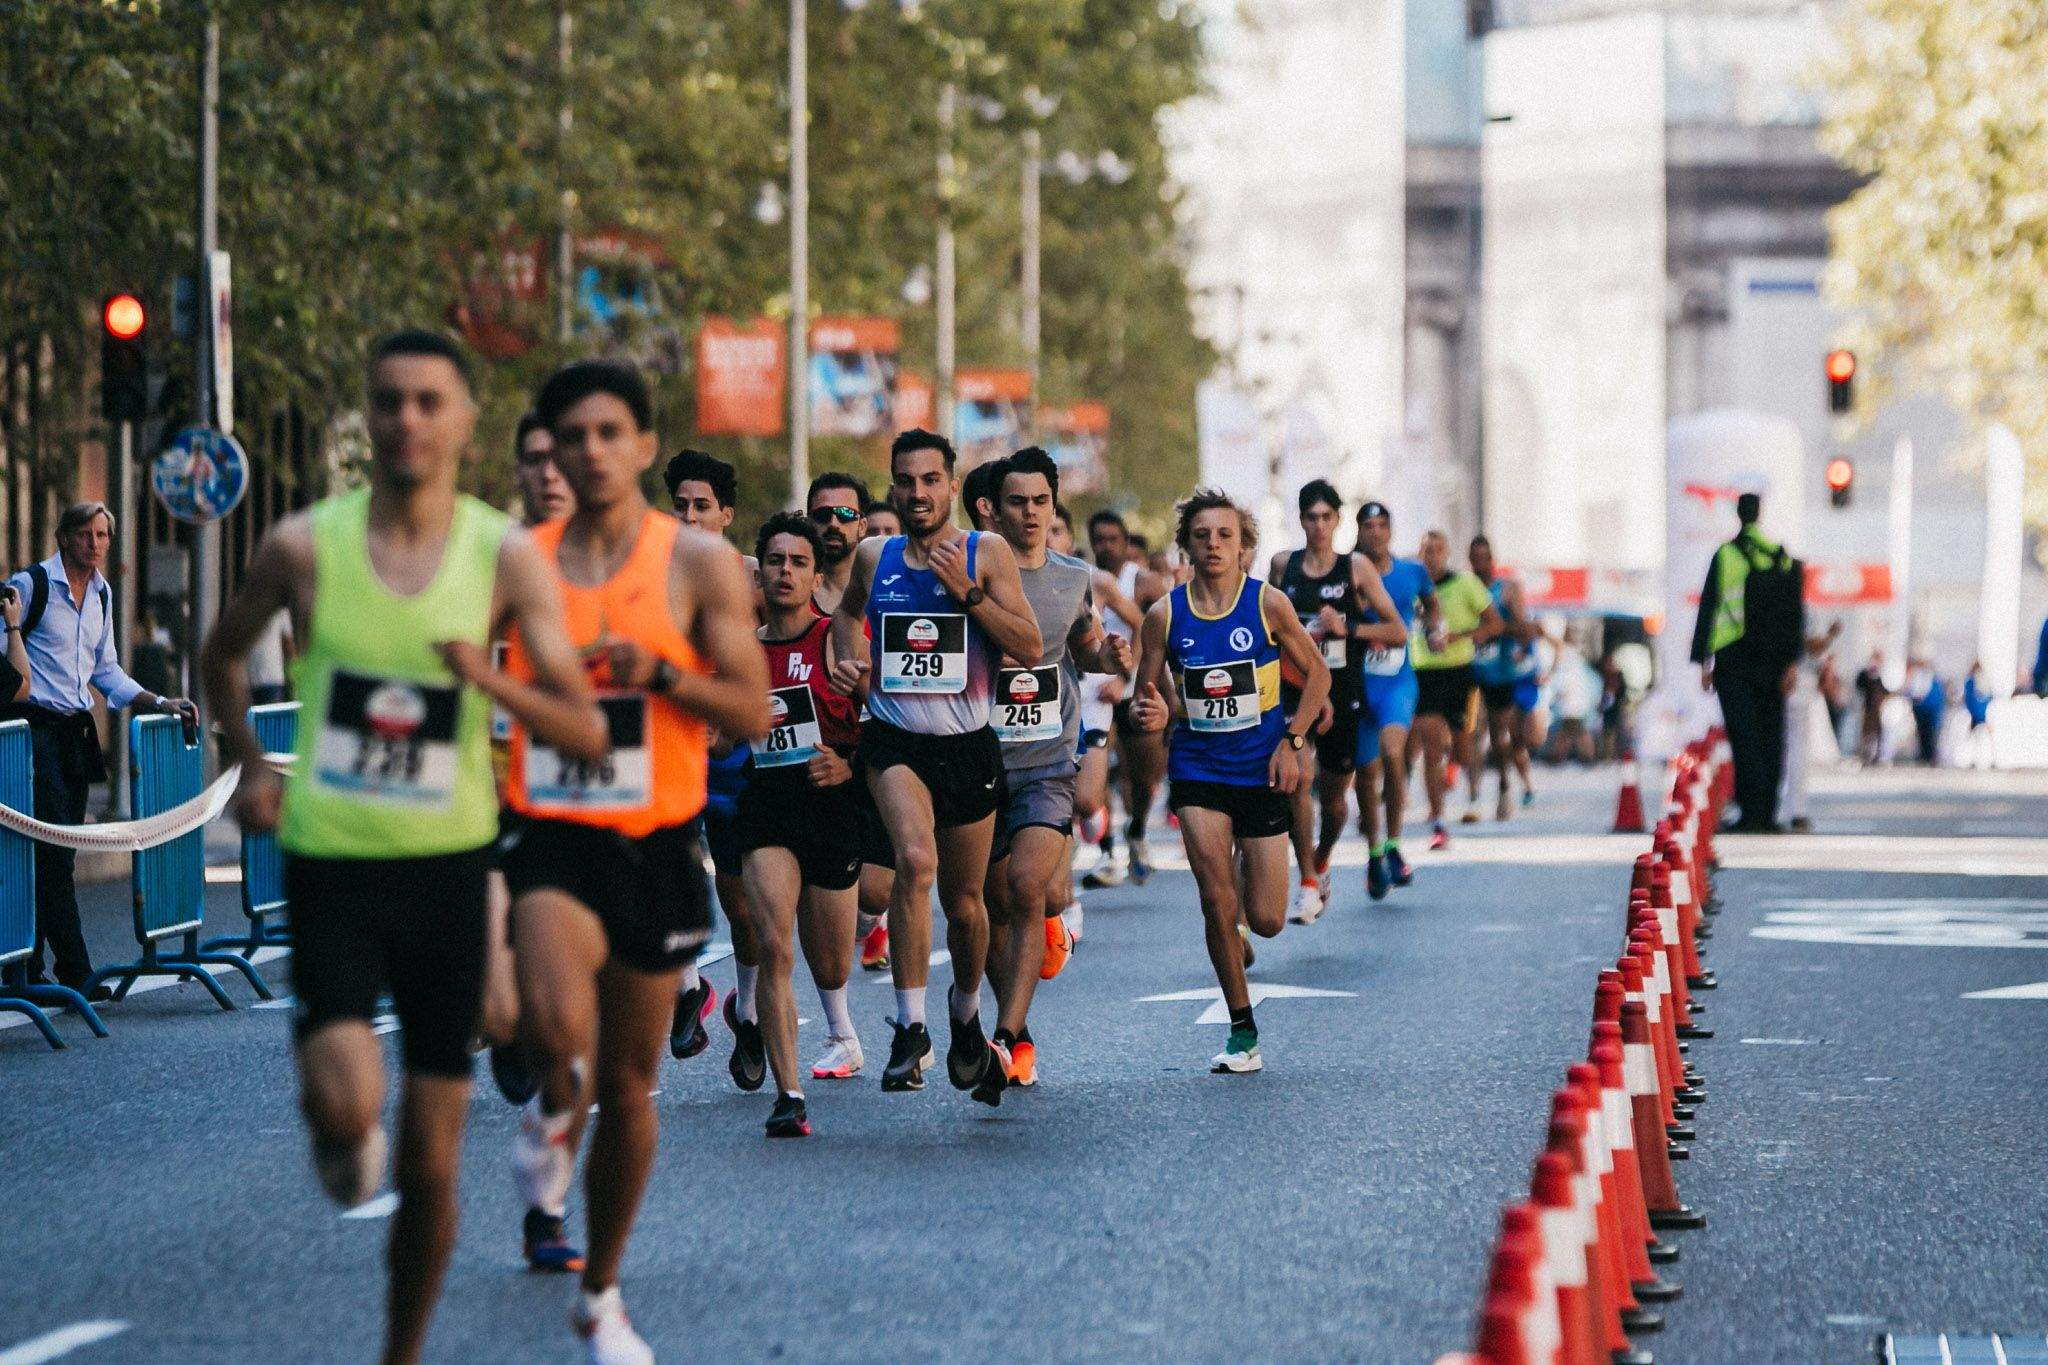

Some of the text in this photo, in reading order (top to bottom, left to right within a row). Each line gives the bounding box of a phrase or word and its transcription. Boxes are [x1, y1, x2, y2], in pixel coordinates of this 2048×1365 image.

[900, 653, 943, 677] 259
[1004, 704, 1042, 727] 245
[1204, 697, 1238, 719] 278
[766, 726, 799, 752] 281
